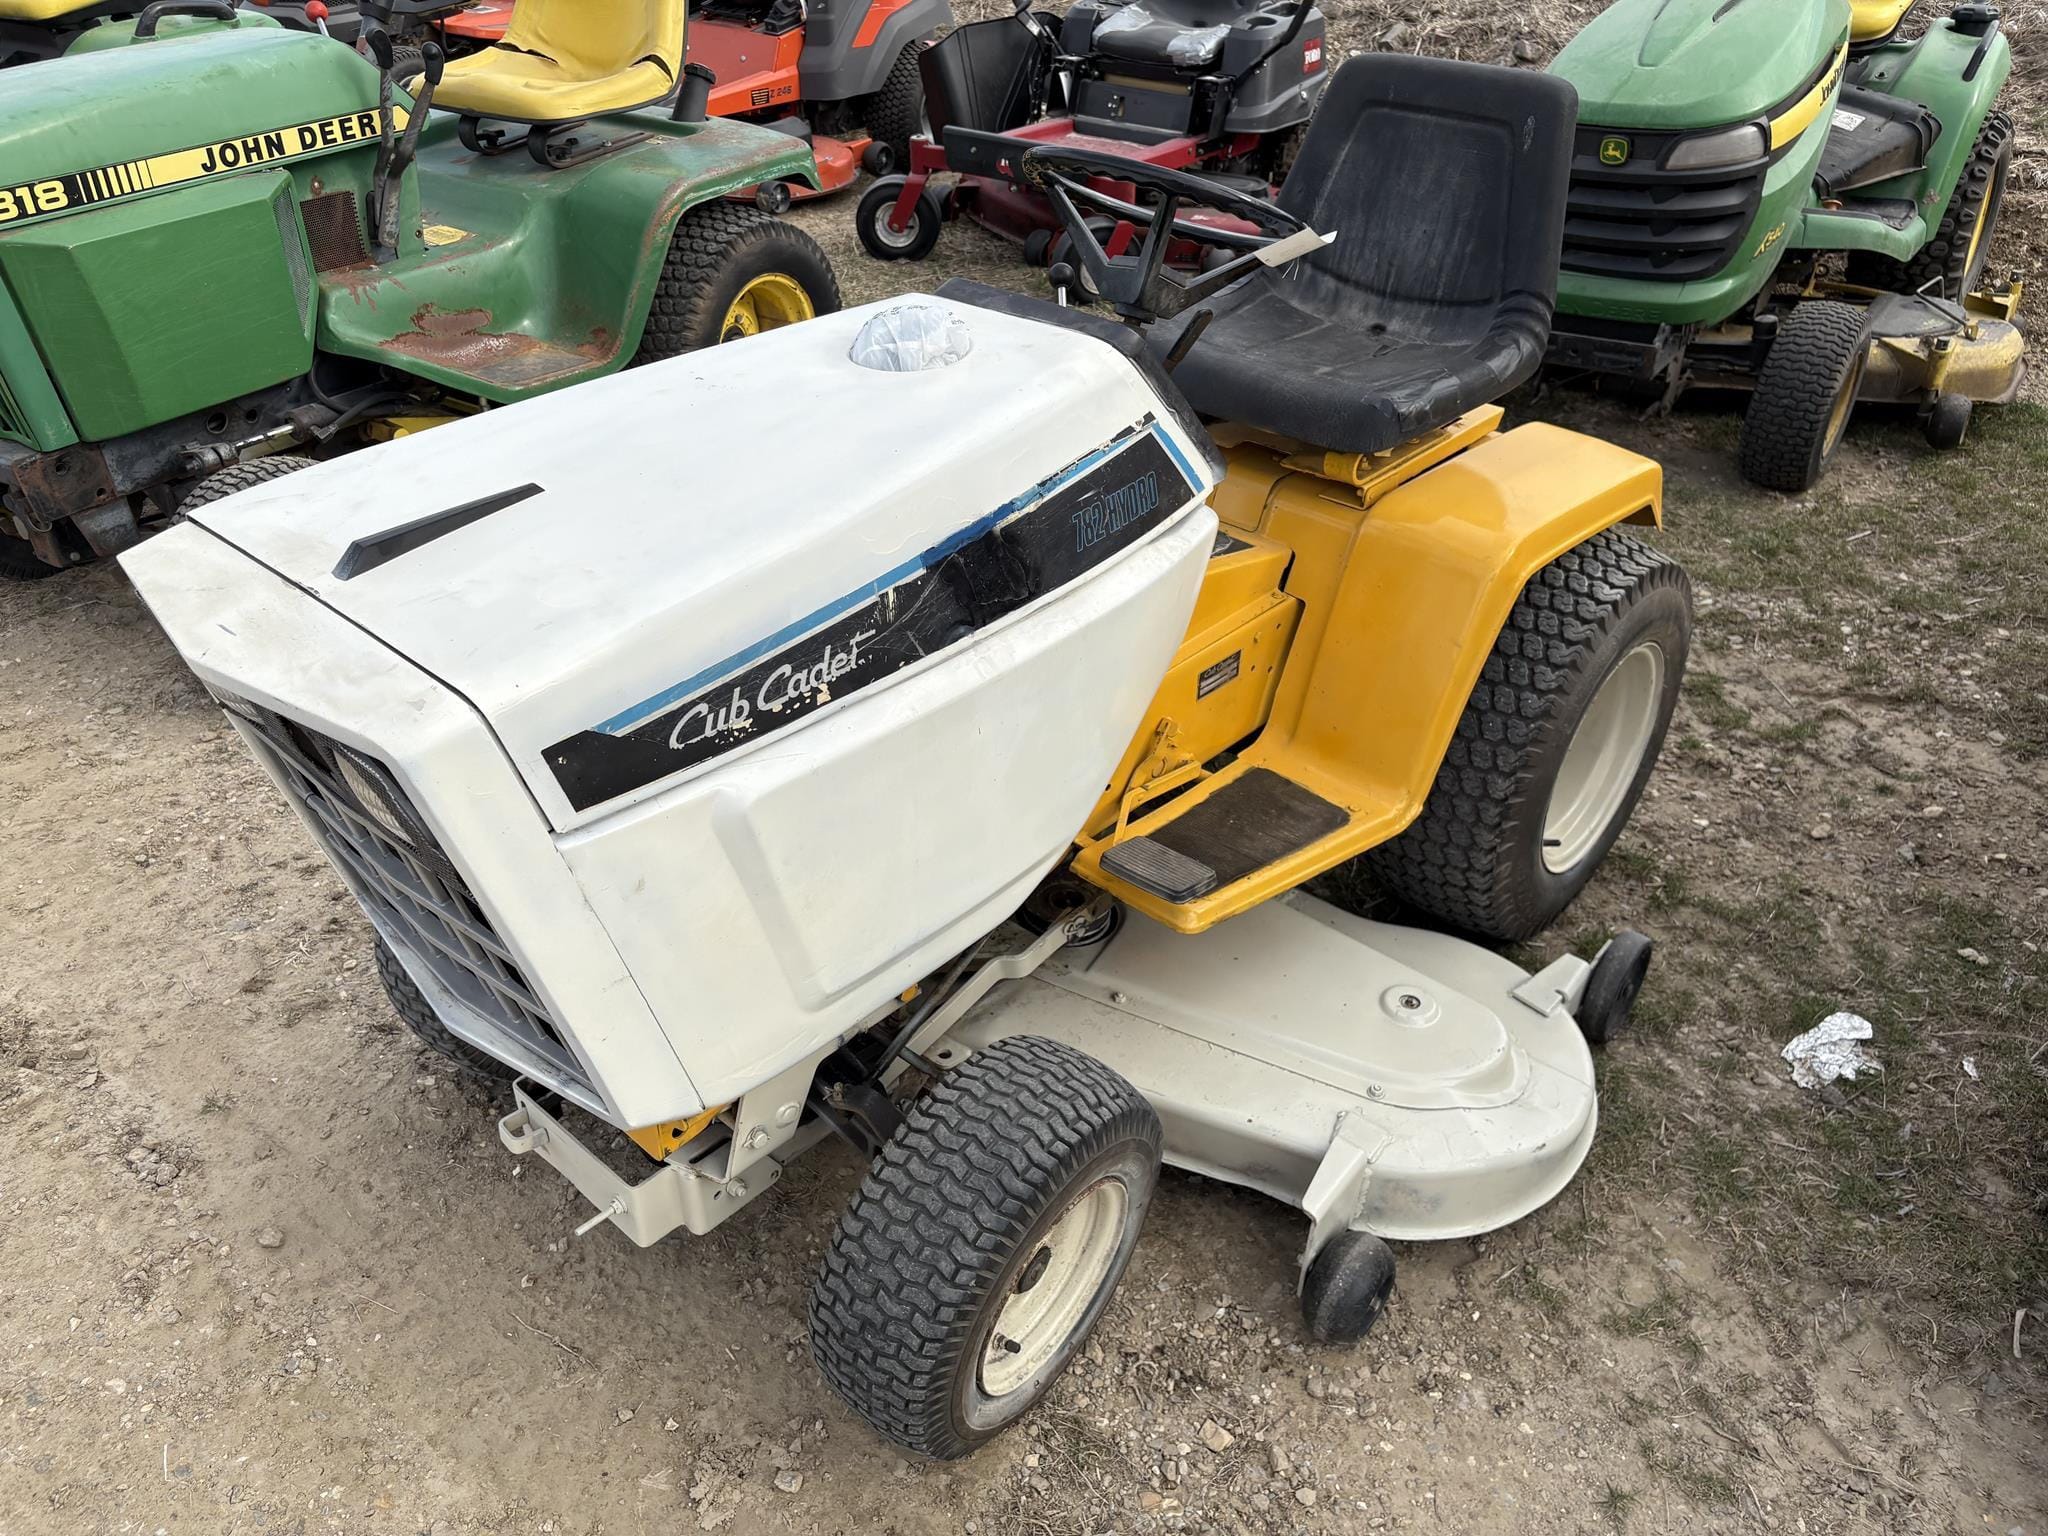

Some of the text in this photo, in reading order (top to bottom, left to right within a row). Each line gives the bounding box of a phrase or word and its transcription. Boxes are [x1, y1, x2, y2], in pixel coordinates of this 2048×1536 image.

[201, 131, 287, 173] JOHN
[297, 110, 397, 151] DEER
[1072, 471, 1160, 553] 782 HYDRO
[669, 628, 877, 750] Cub Cadet
